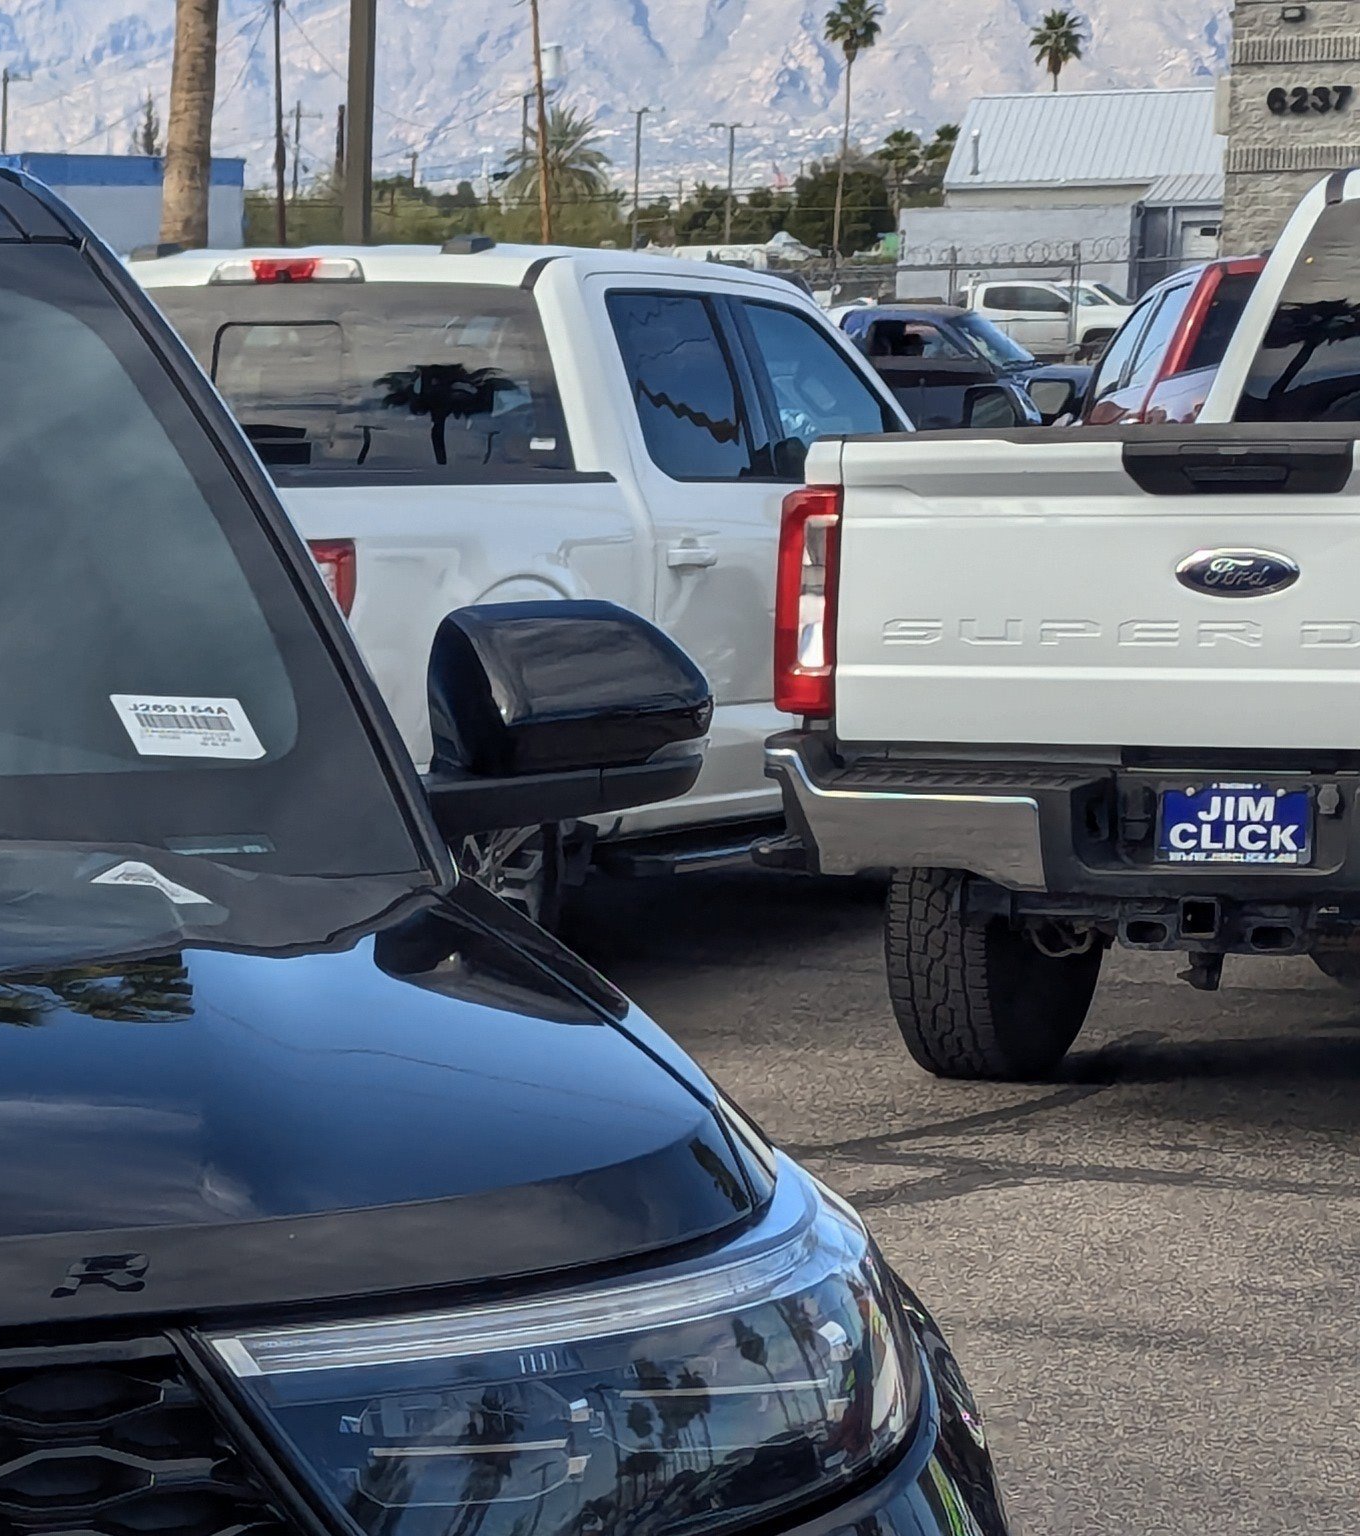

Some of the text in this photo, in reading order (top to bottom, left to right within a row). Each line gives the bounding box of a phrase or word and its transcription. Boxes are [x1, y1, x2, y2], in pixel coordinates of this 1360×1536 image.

[1267, 86, 1353, 116] 6237
[1204, 558, 1271, 586] Ford
[882, 618, 1264, 648] SUPER
[1197, 796, 1275, 821] JIM
[1169, 823, 1299, 850] CLICK
